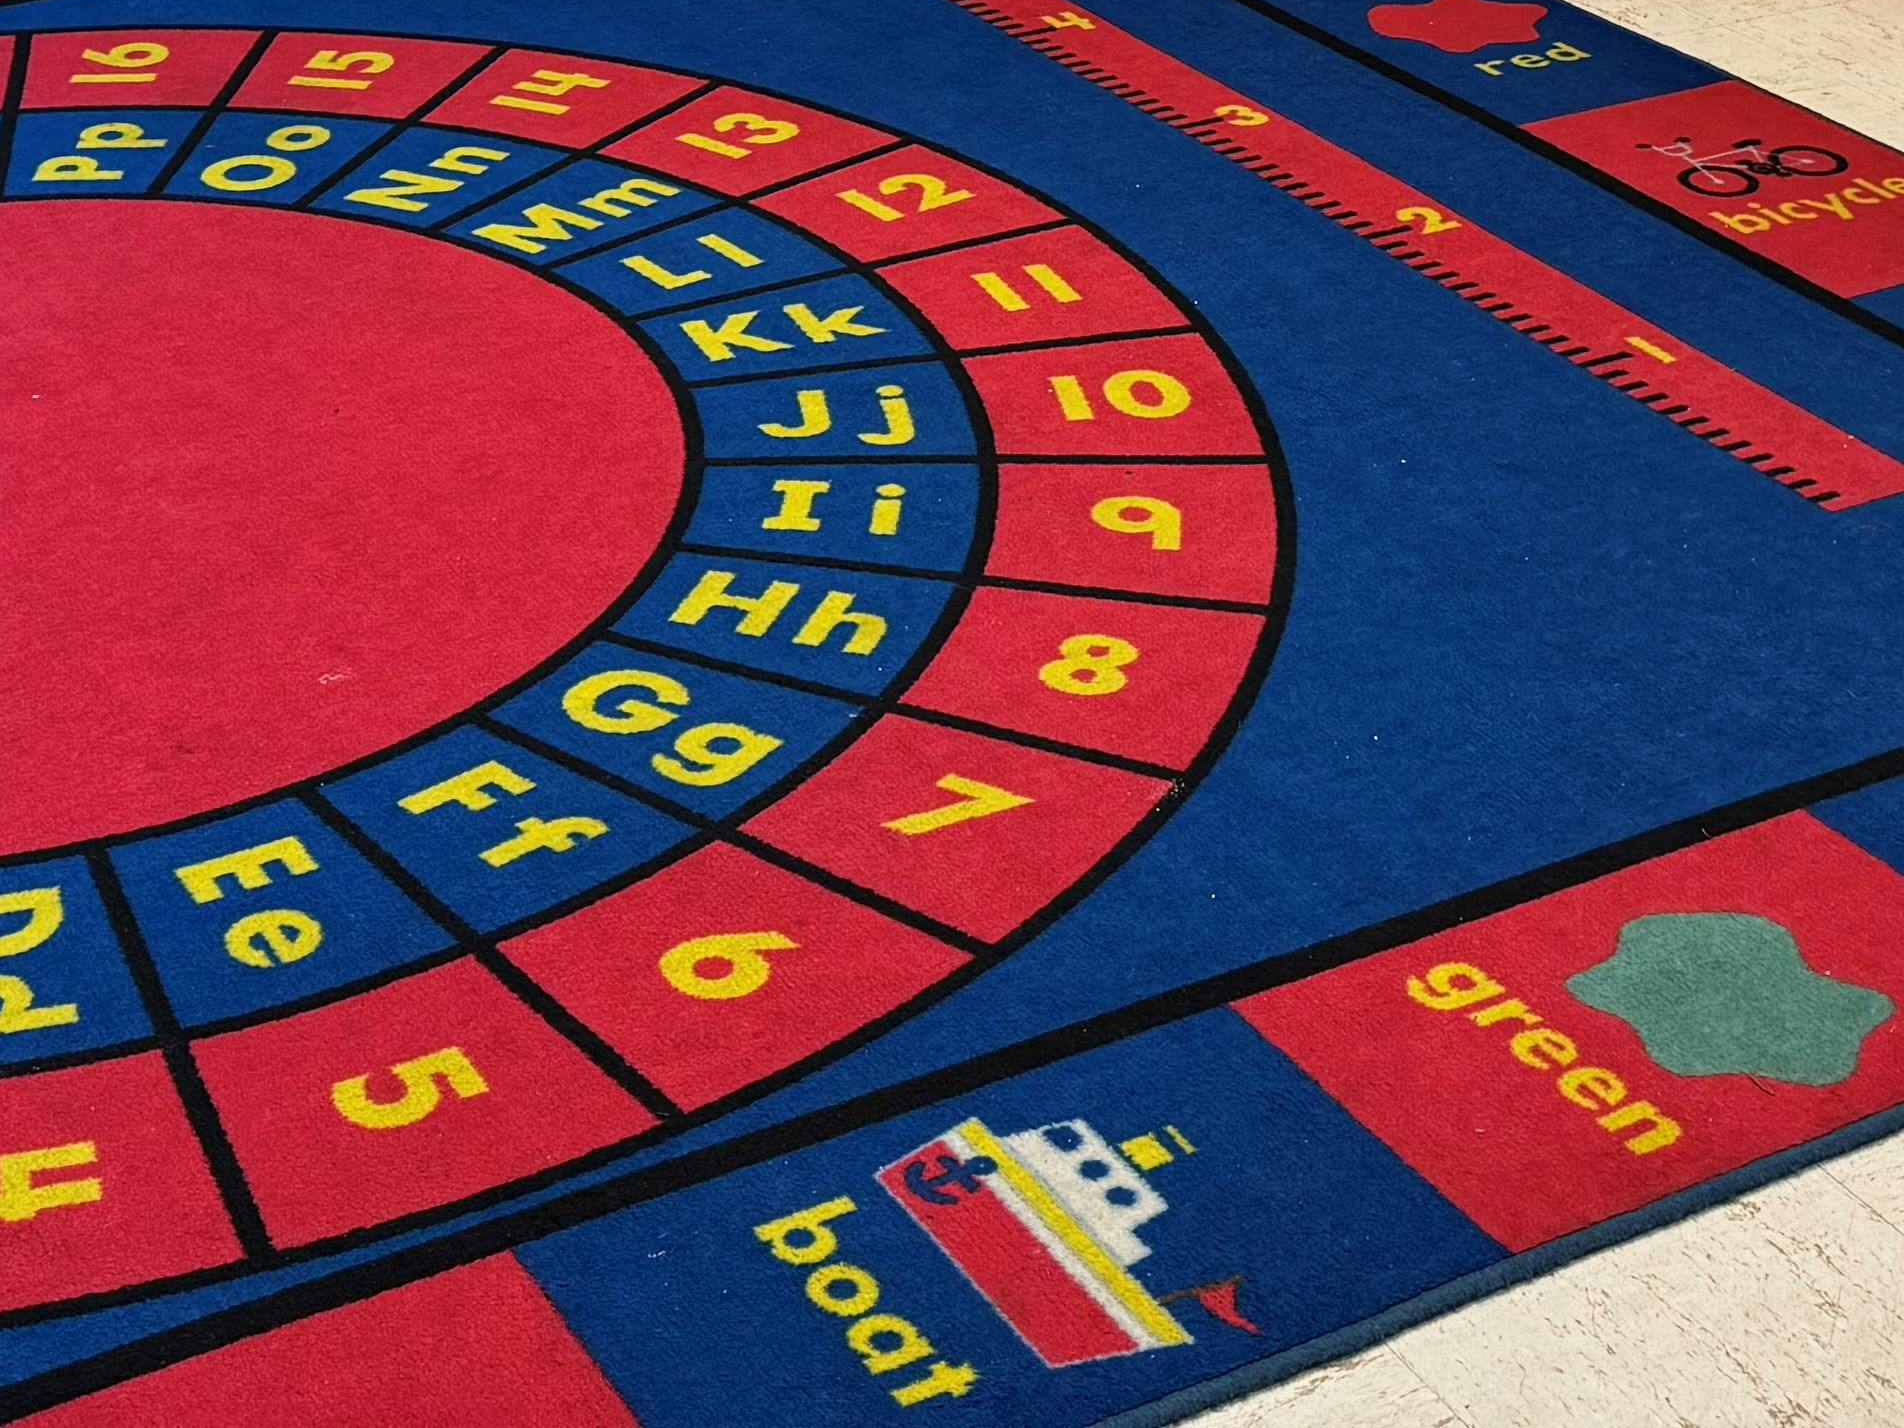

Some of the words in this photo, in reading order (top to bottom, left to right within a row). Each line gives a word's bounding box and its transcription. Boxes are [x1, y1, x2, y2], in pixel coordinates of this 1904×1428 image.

[1480, 44, 1588, 75] red
[678, 113, 800, 159] 13
[1051, 370, 1192, 421] 10
[1091, 496, 1182, 550] 9
[1039, 634, 1140, 695] 8
[884, 773, 1032, 835] 7
[659, 931, 799, 1000] 6
[331, 1048, 489, 1129] 5
[1406, 962, 1682, 1155] green
[756, 1198, 977, 1406] boat
